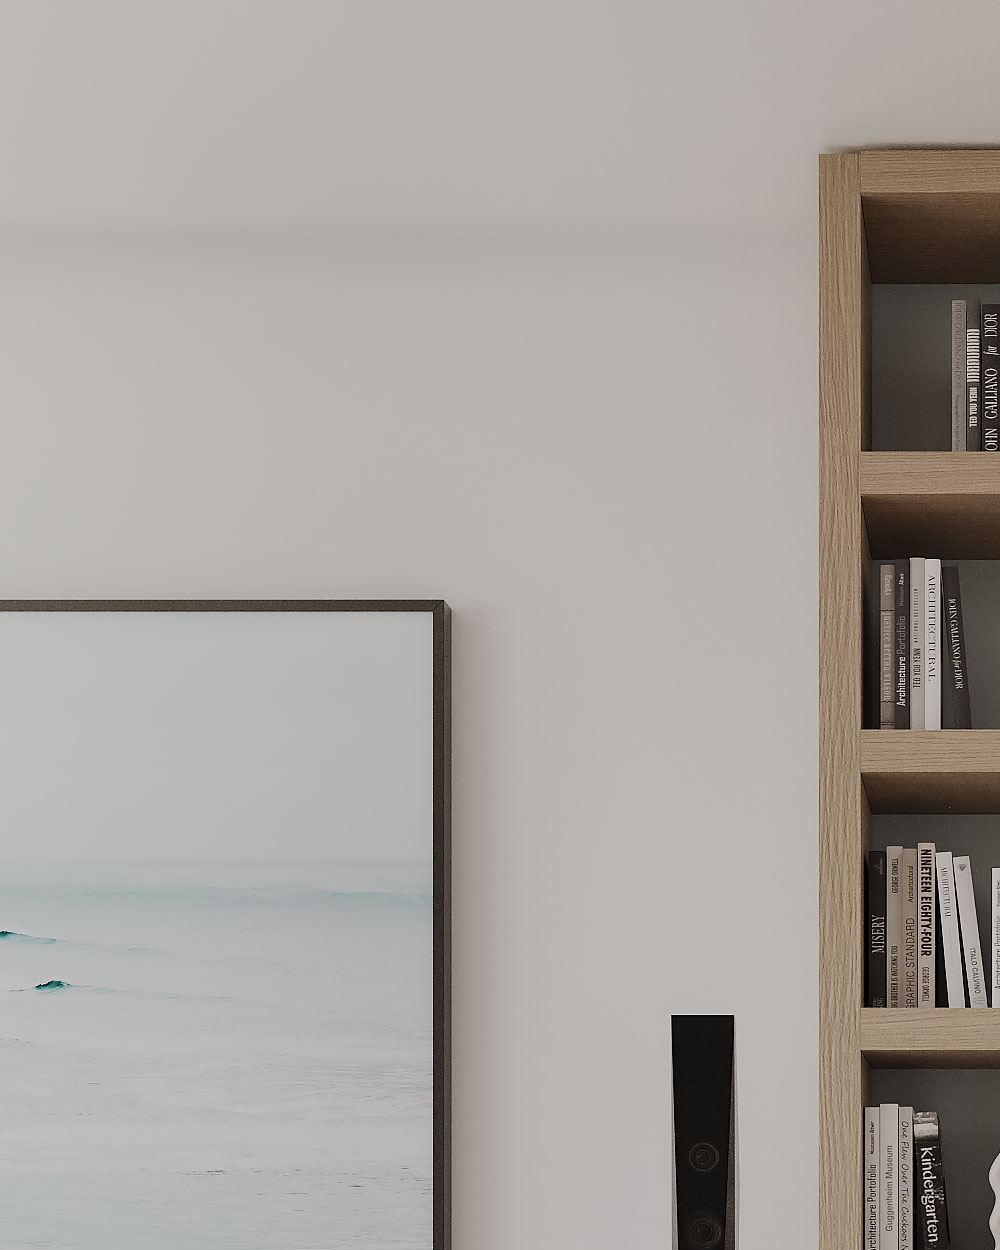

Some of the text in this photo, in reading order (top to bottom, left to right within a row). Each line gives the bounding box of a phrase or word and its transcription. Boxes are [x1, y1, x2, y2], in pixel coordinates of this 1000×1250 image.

[983, 313, 1000, 451] OHN GALLIANO for DIOR
[896, 615, 906, 654] Portofolio
[927, 574, 937, 682] ARCHITECTURAL
[896, 656, 906, 706] Architecture
[920, 849, 932, 957] NINETEEN EIGHTY-FOUR
[871, 914, 885, 953] MISERY
[906, 917, 915, 968] STANDARD
[970, 948, 981, 994] ITALO CALVINO
[901, 1121, 909, 1138] One
[901, 1141, 909, 1161] Flew
[867, 1164, 877, 1202] Portofolio
[885, 1145, 894, 1232] Guggenheim Museum
[901, 1164, 909, 1185] Over
[901, 1188, 909, 1204] The
[920, 1147, 939, 1243] Kindergarten
